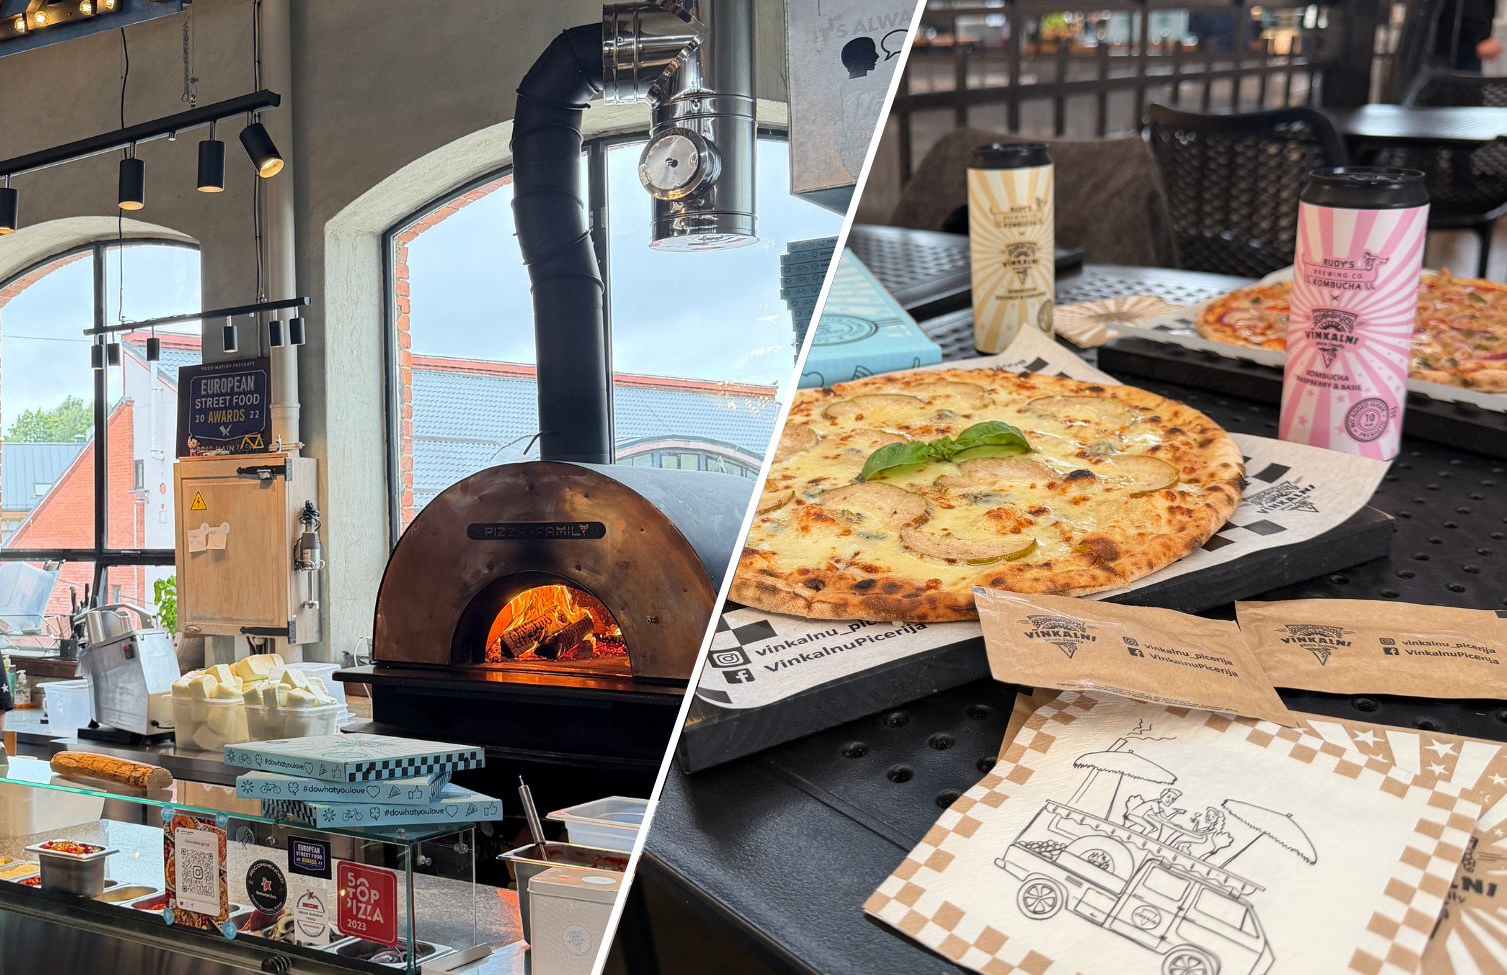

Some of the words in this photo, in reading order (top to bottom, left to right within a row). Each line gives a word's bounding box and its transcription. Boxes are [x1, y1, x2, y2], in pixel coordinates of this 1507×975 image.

[1323, 258, 1355, 269] RUDY'S
[1313, 269, 1348, 279] BREWING
[1313, 279, 1362, 291] KOMBUCHA
[1306, 369, 1349, 382] KOMBUCHA
[201, 375, 255, 395] EUROPEAN
[1296, 375, 1331, 389] RASPBERRY
[1341, 383, 1362, 392] BASIL
[195, 396, 231, 409] STREET
[233, 394, 260, 406] FOOD
[208, 409, 245, 423] AWARDS
[250, 410, 260, 418] 22
[764, 620, 928, 673] VinkalnuPicerija
[1402, 640, 1497, 654] vinkalnu_picerija
[1144, 643, 1233, 666] vinkalnu_picerija
[1405, 650, 1500, 665] VinkalnuPicerija
[1149, 653, 1239, 677] VinkalnuPicerija
[264, 758, 304, 770] #dowhatyoulove
[303, 785, 365, 795] #dowhatyoulove
[384, 807, 444, 817] #dowhatyoulove
[297, 843, 321, 854] EUROPEAN
[347, 885, 380, 904] TOP
[347, 919, 367, 931] 2023
